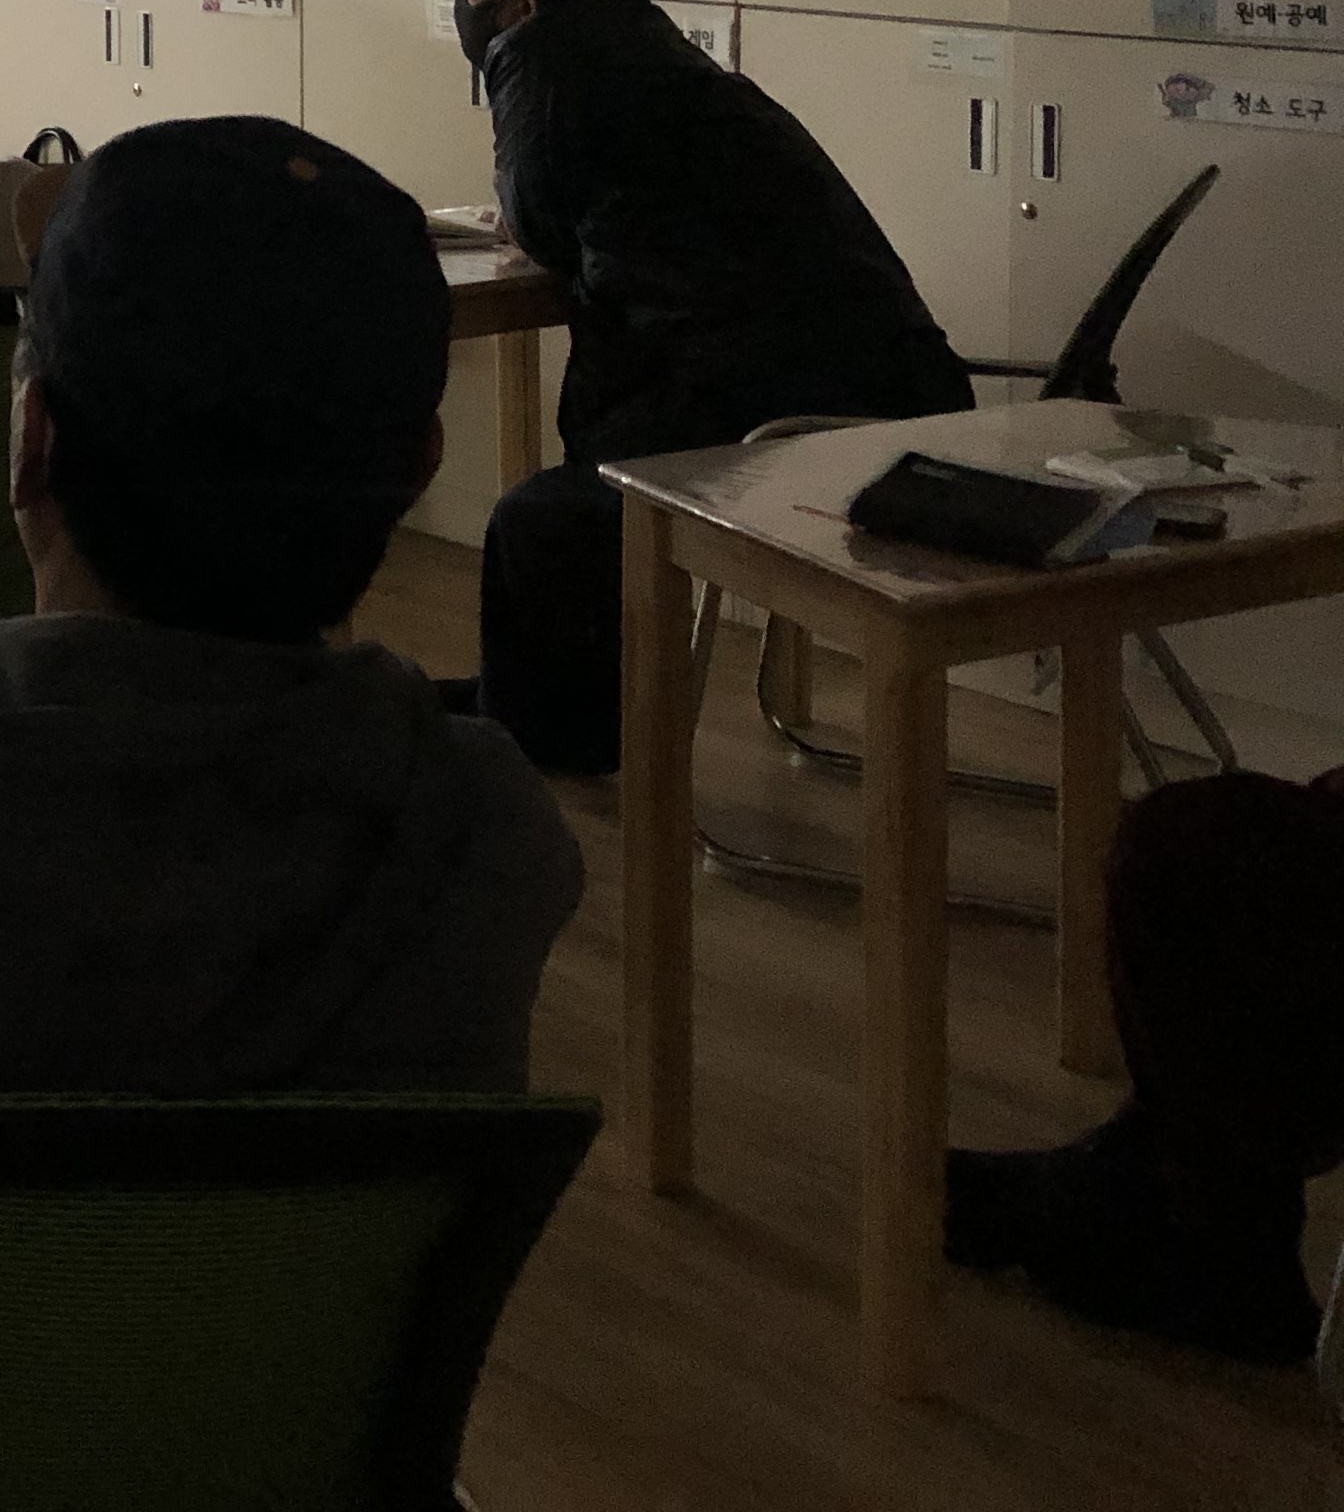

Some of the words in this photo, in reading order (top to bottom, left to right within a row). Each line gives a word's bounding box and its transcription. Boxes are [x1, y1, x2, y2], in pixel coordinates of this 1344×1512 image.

[686, 29, 715, 50] 게임
[1232, 90, 1275, 116] 청소
[1284, 97, 1328, 123] 도구
